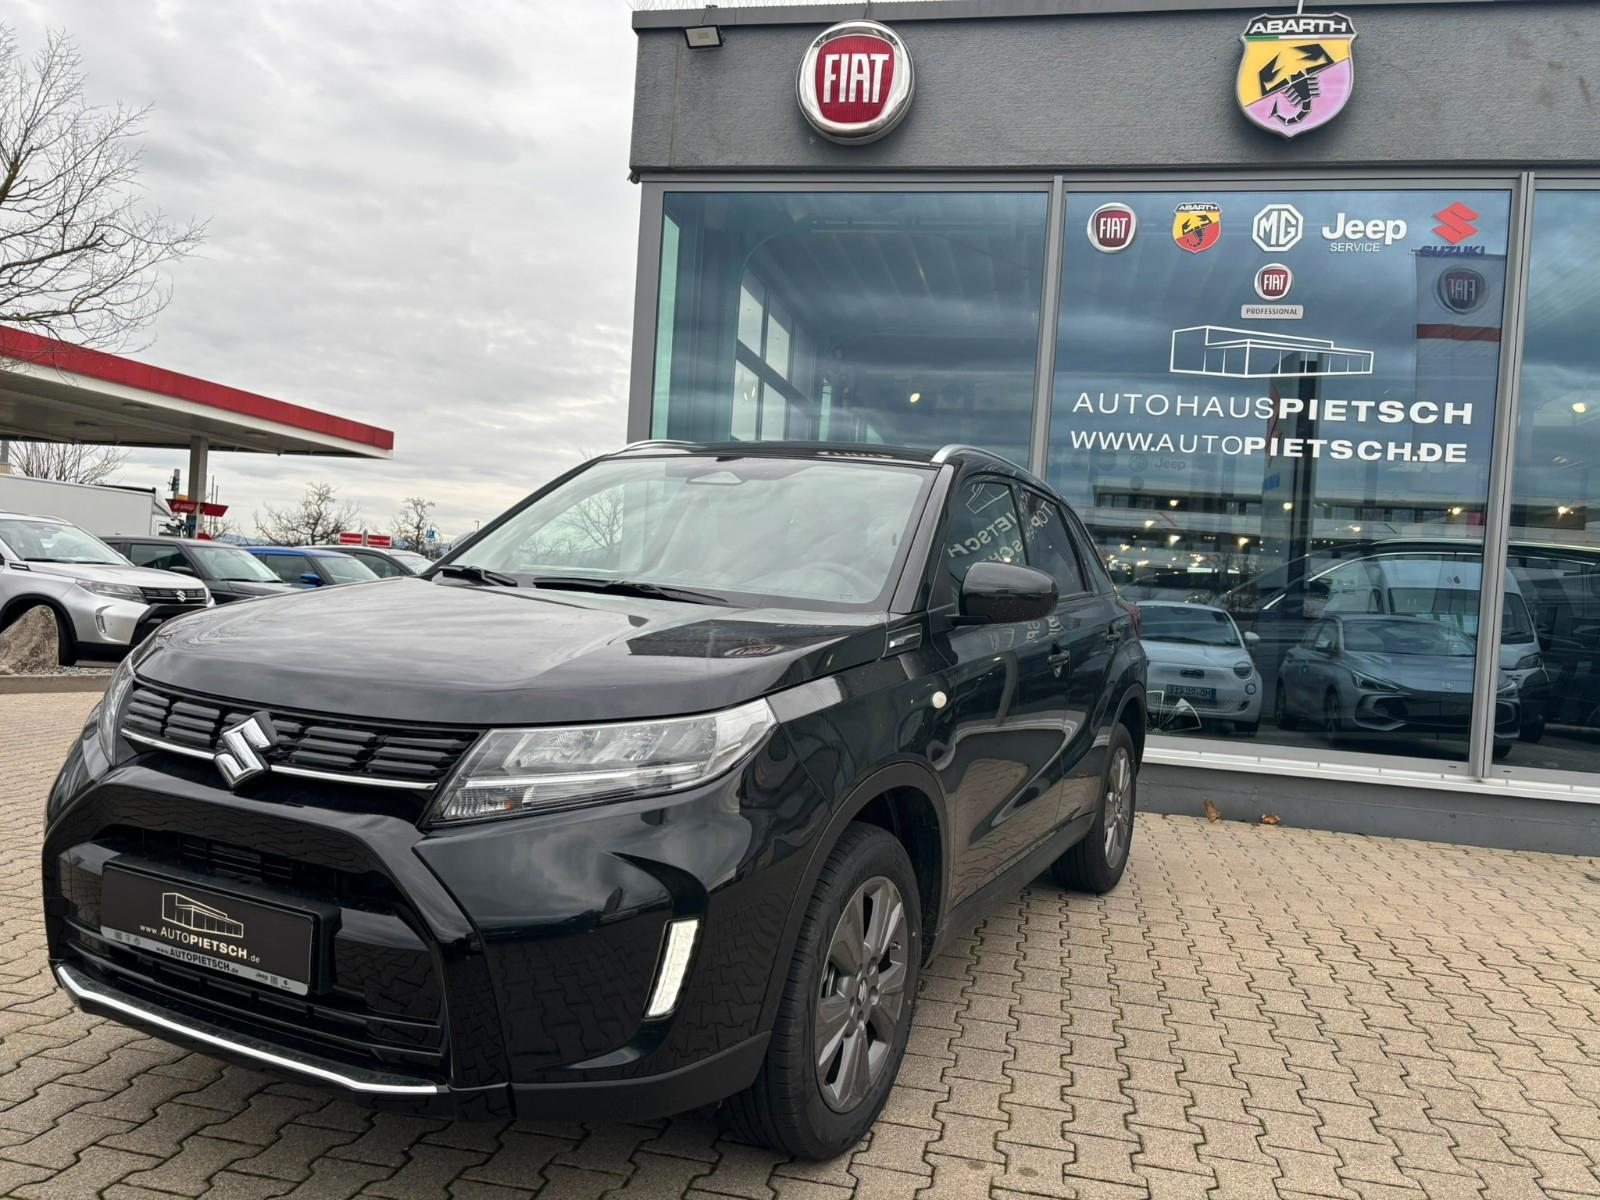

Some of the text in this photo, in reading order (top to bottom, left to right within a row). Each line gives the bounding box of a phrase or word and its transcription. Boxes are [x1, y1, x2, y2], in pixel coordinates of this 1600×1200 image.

[1249, 19, 1347, 34] ABARTH
[823, 53, 889, 104] FIAT
[1178, 203, 1219, 211] ABARTH
[1099, 217, 1127, 239] FIAT
[1259, 210, 1297, 245] MG
[1322, 212, 1407, 245] Jeep
[1329, 242, 1381, 252] SERVICE
[1420, 246, 1485, 257] SUZUKI
[1263, 274, 1287, 291] FIAT
[1245, 307, 1299, 317] PROFESSIONAL
[1072, 392, 1473, 425] AUTOHAUSPIETSCH
[1070, 430, 1468, 463] WWW.AUTOPIETSCH.DE
